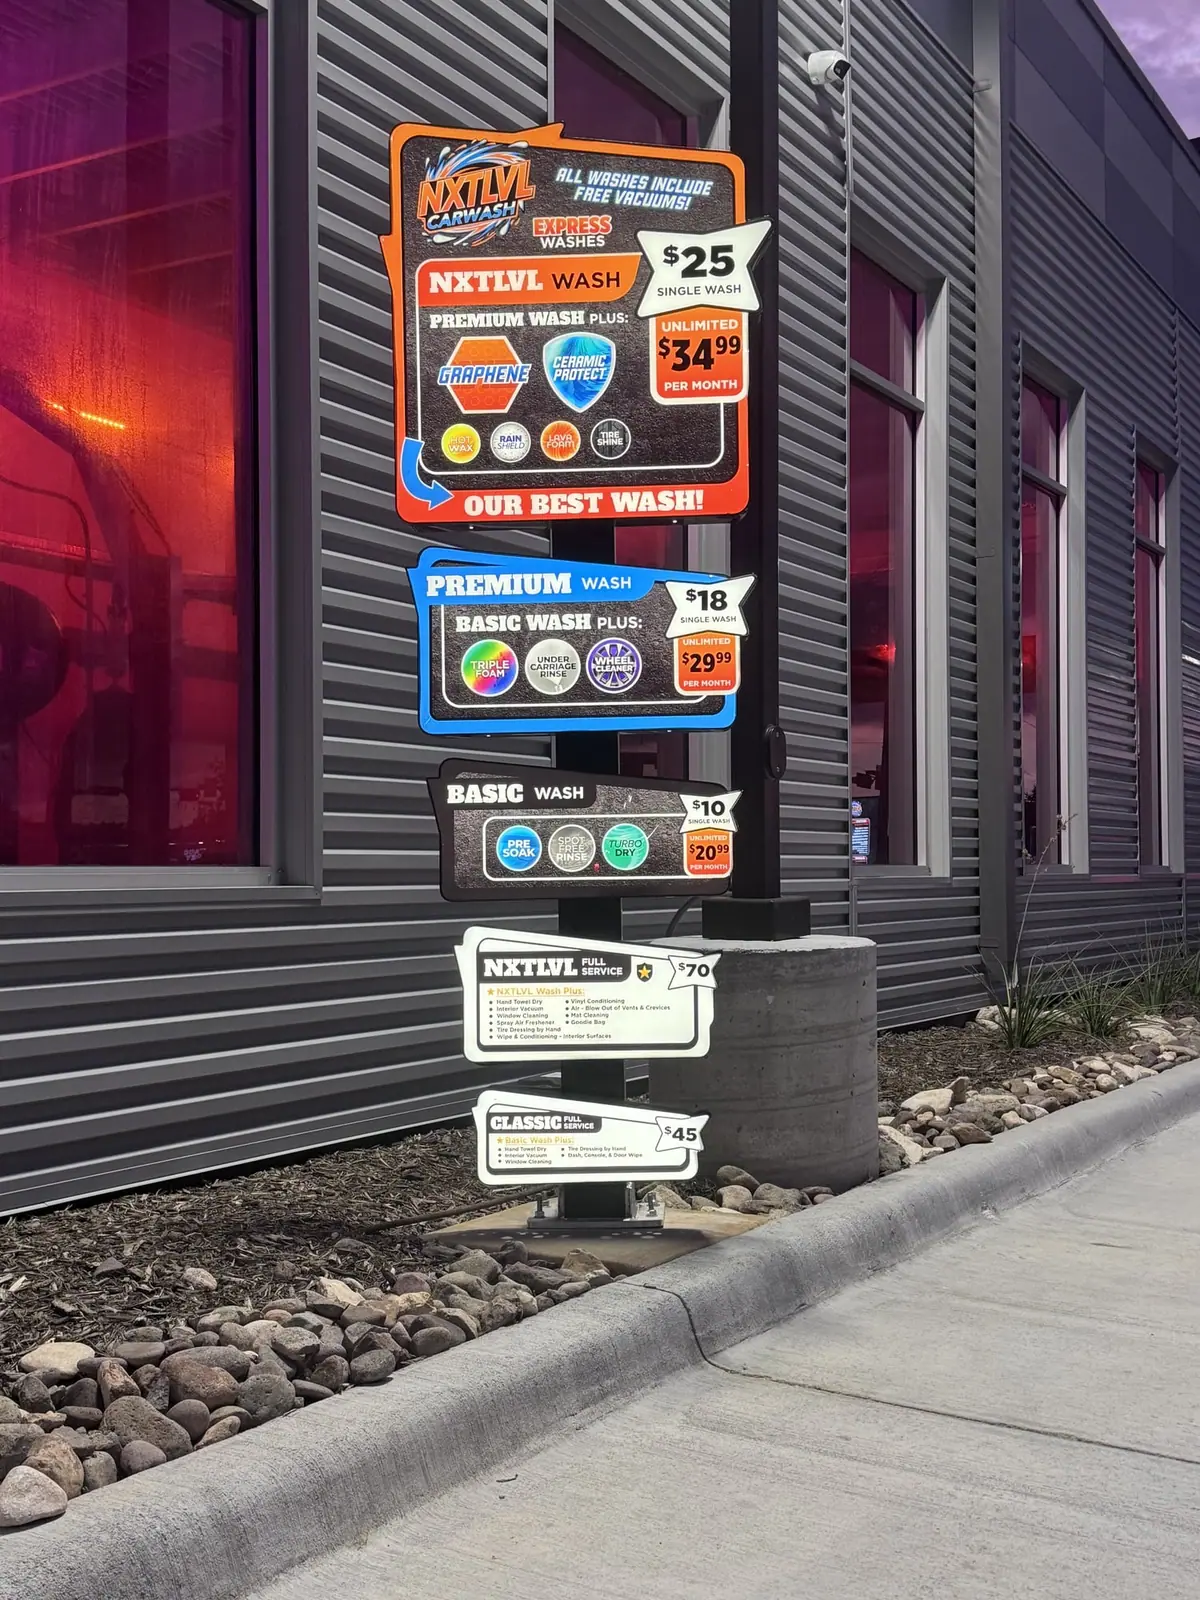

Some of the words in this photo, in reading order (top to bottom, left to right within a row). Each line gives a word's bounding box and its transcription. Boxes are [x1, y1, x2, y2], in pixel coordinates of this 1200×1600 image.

[556, 168, 582, 183] ALL
[588, 171, 647, 190] WASHES
[651, 176, 713, 195] INCLUDE
[417, 159, 536, 218] NXTLVL
[574, 186, 611, 202] FREE
[614, 190, 692, 211] VACUUMS!
[426, 201, 515, 230] CARWASH
[533, 215, 612, 236] EXPRESS
[540, 235, 605, 248] WASHES
[663, 244, 735, 278] $25
[429, 269, 543, 294] NXTLVL
[552, 271, 620, 289] WASH
[657, 285, 701, 297] SINGLE
[705, 284, 741, 295] WASH
[429, 313, 524, 329] PREMIUM
[529, 311, 584, 326] WASH
[589, 312, 629, 325] PLUS:
[661, 318, 738, 332] UNLIMITED
[553, 356, 606, 368] CERAMIC
[437, 363, 531, 385] GRAPHENE
[553, 367, 607, 381] PROTECT
[664, 380, 689, 392] PER
[691, 379, 738, 391] MONTH
[499, 435, 522, 443] RAIN
[548, 434, 573, 442] LAVA
[600, 431, 620, 439] TIRE
[451, 436, 471, 445] HOT
[497, 441, 525, 450] SHIELD
[547, 440, 574, 448] FOAM
[597, 437, 623, 445] SHINE
[449, 443, 473, 453] WAX
[464, 494, 524, 516] OUR
[530, 493, 603, 515] BEST
[610, 489, 703, 511] WASH!
[426, 572, 572, 597] PREMIUM
[581, 576, 632, 590] WASH
[685, 589, 728, 611] $18
[456, 615, 521, 633] BASIC
[525, 613, 592, 631] WASH
[597, 615, 643, 629] PLUS:
[680, 616, 709, 624] SINGLE
[711, 615, 737, 623] WASH
[682, 637, 731, 646] UNLIMITED
[537, 655, 570, 664] UNDER
[595, 656, 634, 666] WHEEL
[471, 660, 510, 670] TRIPLE
[530, 662, 577, 671] CARRIAGE
[595, 664, 633, 673] CLEANER
[475, 668, 505, 678] FOAM
[540, 670, 567, 678] RINSE
[683, 680, 699, 688] PER
[701, 679, 731, 687] MONTH
[447, 783, 524, 804] BASIC
[534, 786, 584, 800] WASH
[692, 800, 725, 817] $10
[507, 839, 530, 849] PRE
[558, 836, 586, 845] SPOT
[608, 839, 642, 849] TURBO
[503, 847, 536, 858] SOAK
[558, 844, 585, 853] FREE
[615, 848, 636, 857] DRY
[556, 852, 588, 862] RINSE
[581, 957, 606, 966] FULL
[484, 958, 578, 977] NXTLVL
[581, 967, 623, 976] SERVICE
[678, 962, 710, 978] $70
[536, 987, 561, 995] Wash
[563, 987, 585, 995] Plus:
[490, 1116, 562, 1130] CLASSIC
[664, 1126, 697, 1142] $45
